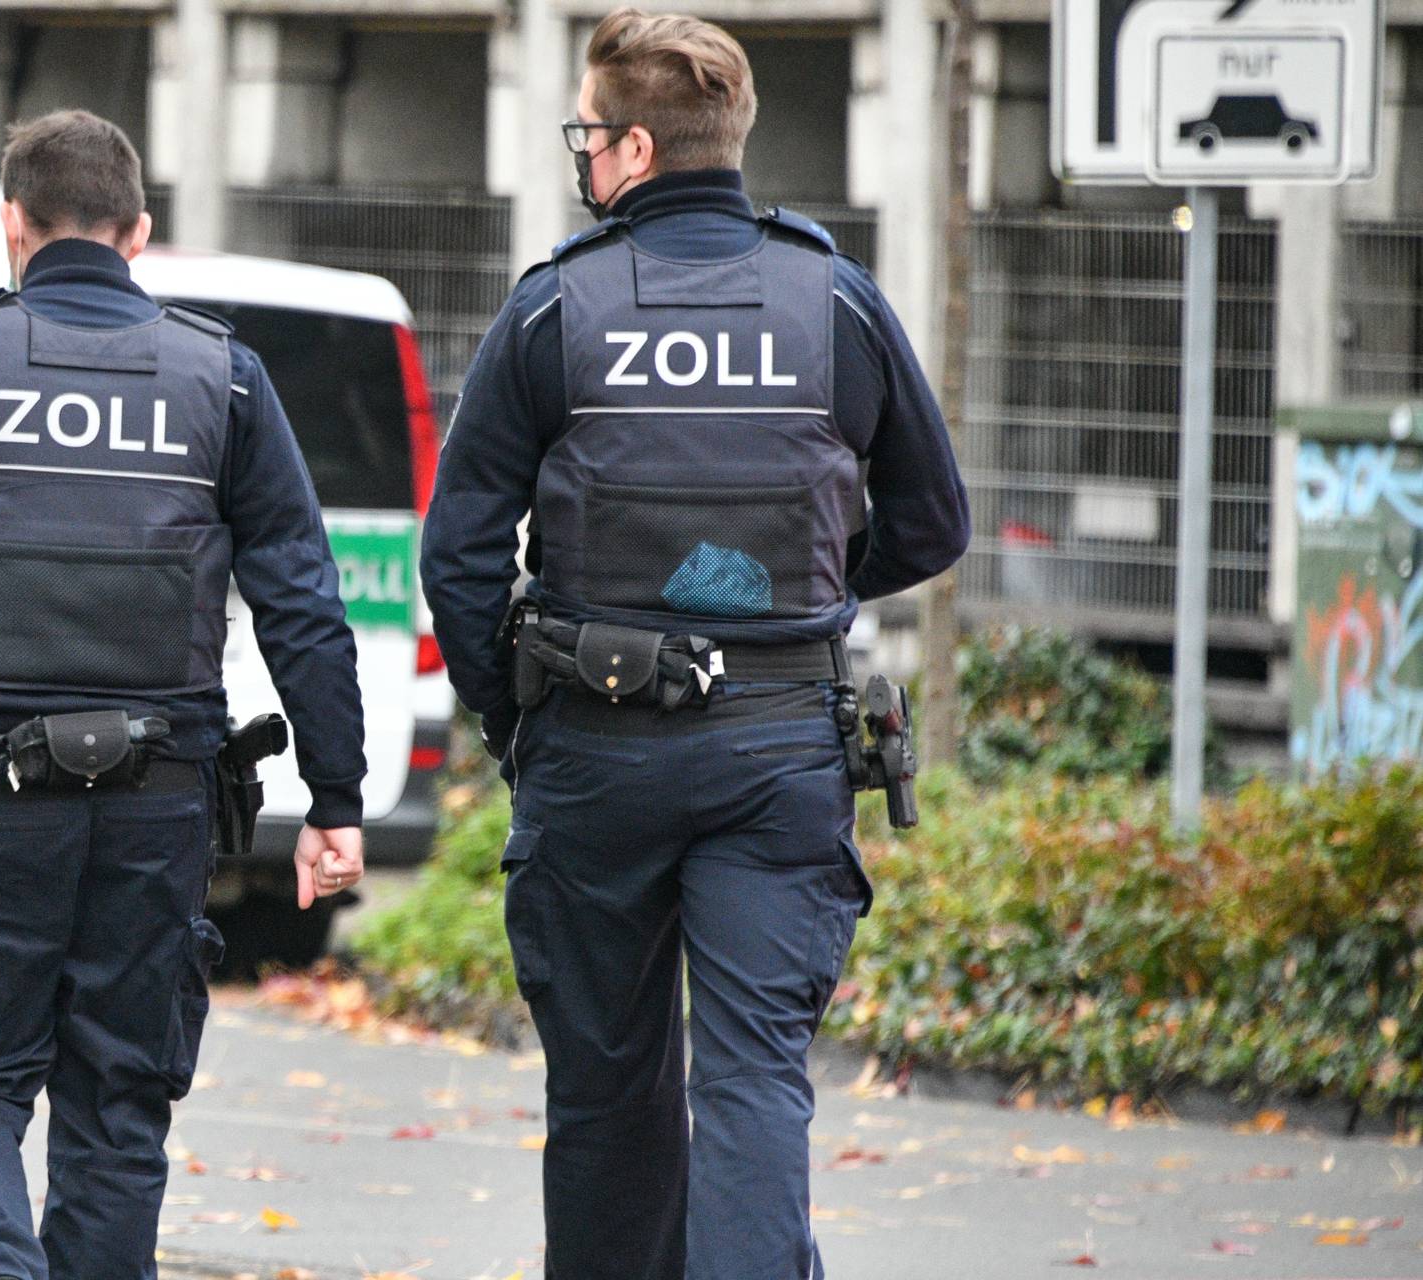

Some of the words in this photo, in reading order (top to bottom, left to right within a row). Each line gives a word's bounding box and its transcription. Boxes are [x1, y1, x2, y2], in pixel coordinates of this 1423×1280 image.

[1219, 48, 1279, 79] nur
[605, 331, 797, 386] ZOLL
[338, 555, 405, 602] OLL
